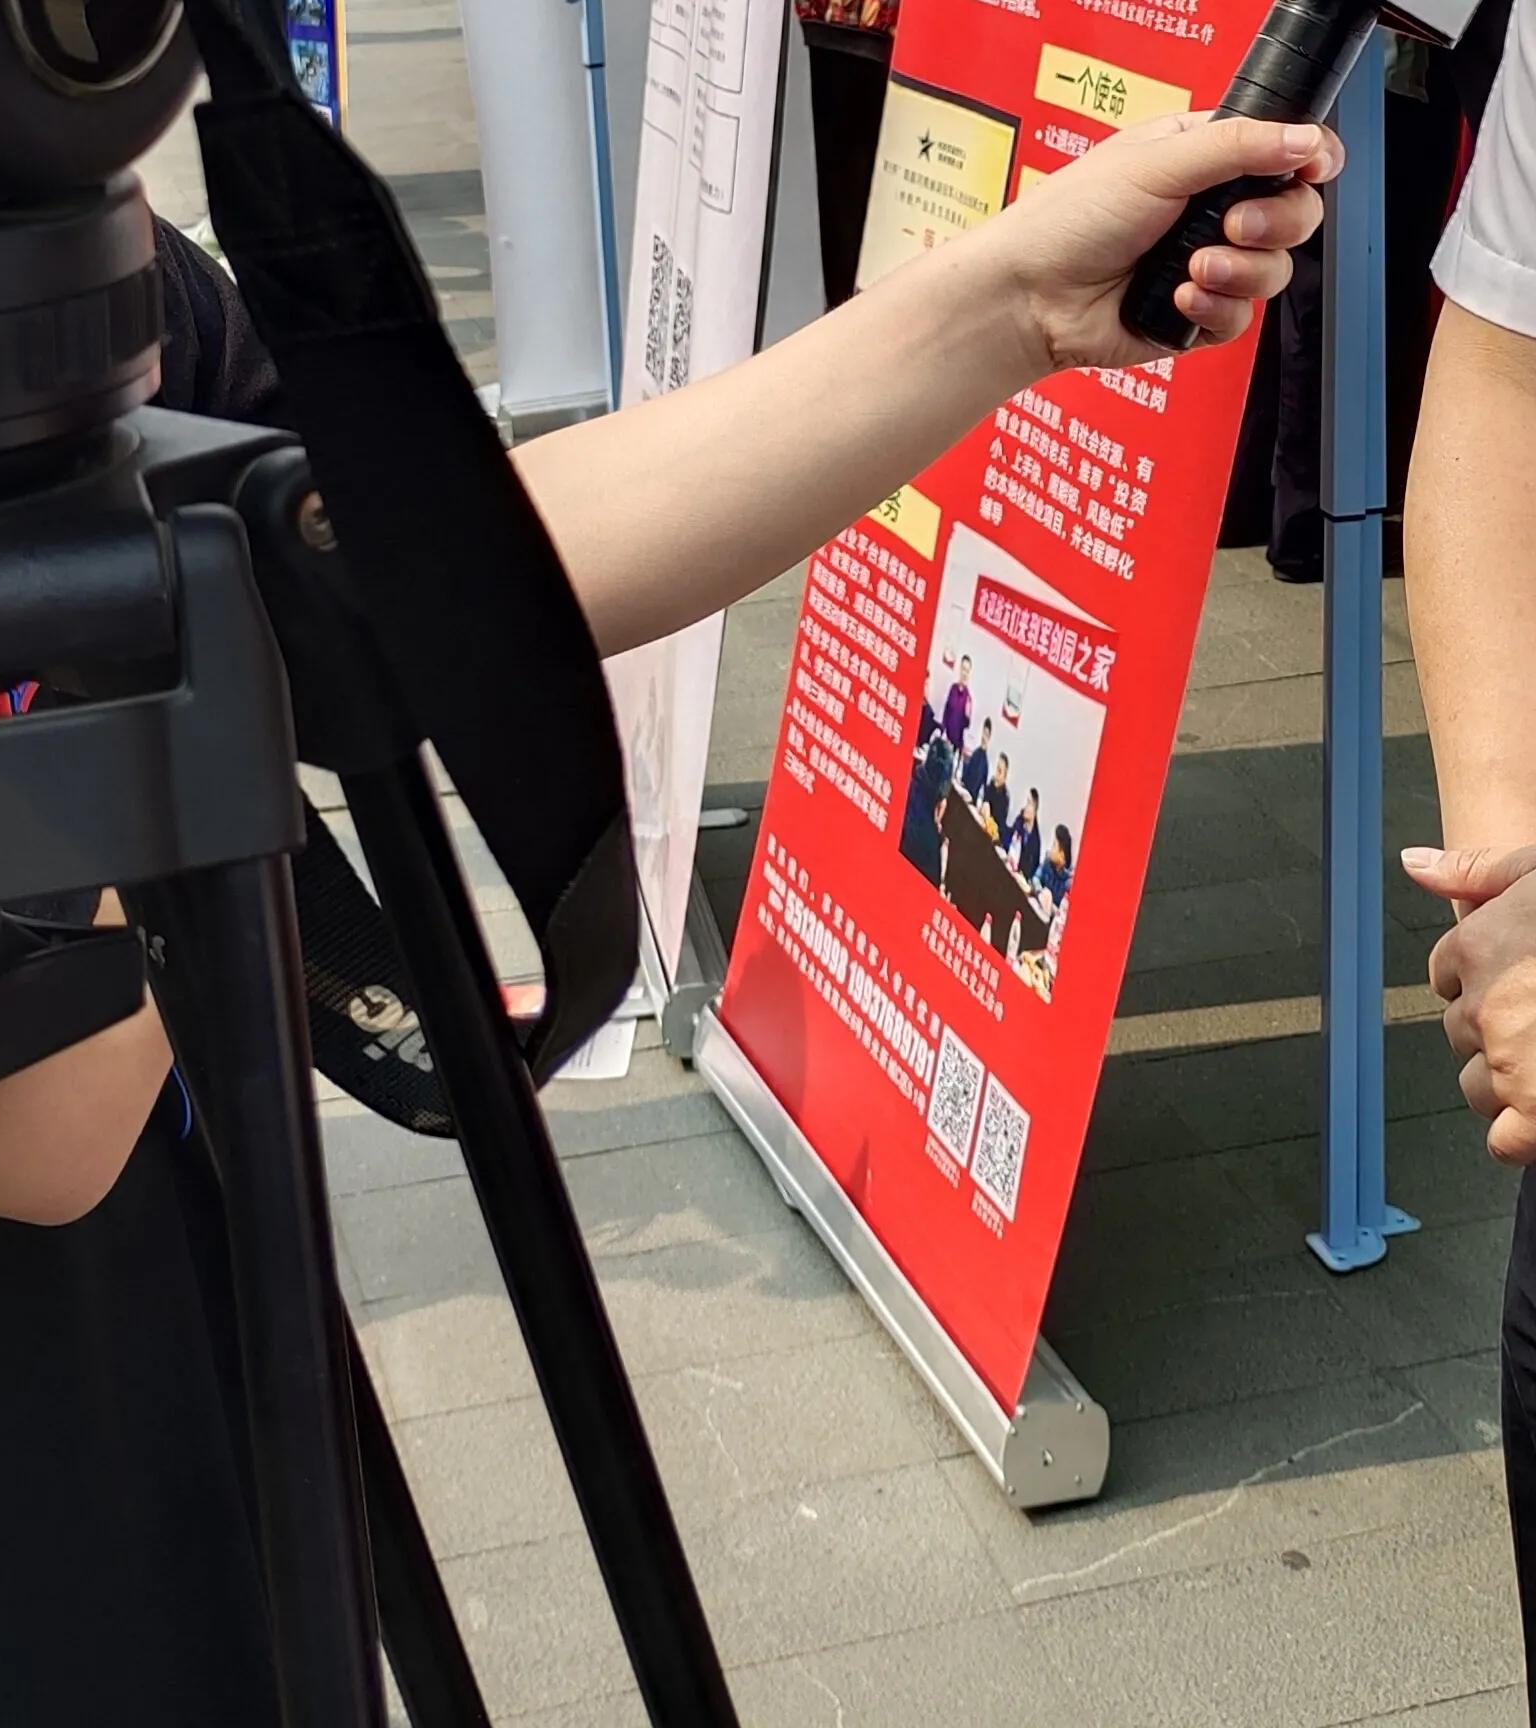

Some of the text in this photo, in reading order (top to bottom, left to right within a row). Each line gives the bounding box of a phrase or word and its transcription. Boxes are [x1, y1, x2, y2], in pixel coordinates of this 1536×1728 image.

[1056, 66, 1128, 120] 一个使命
[783, 886, 849, 985] 55130998
